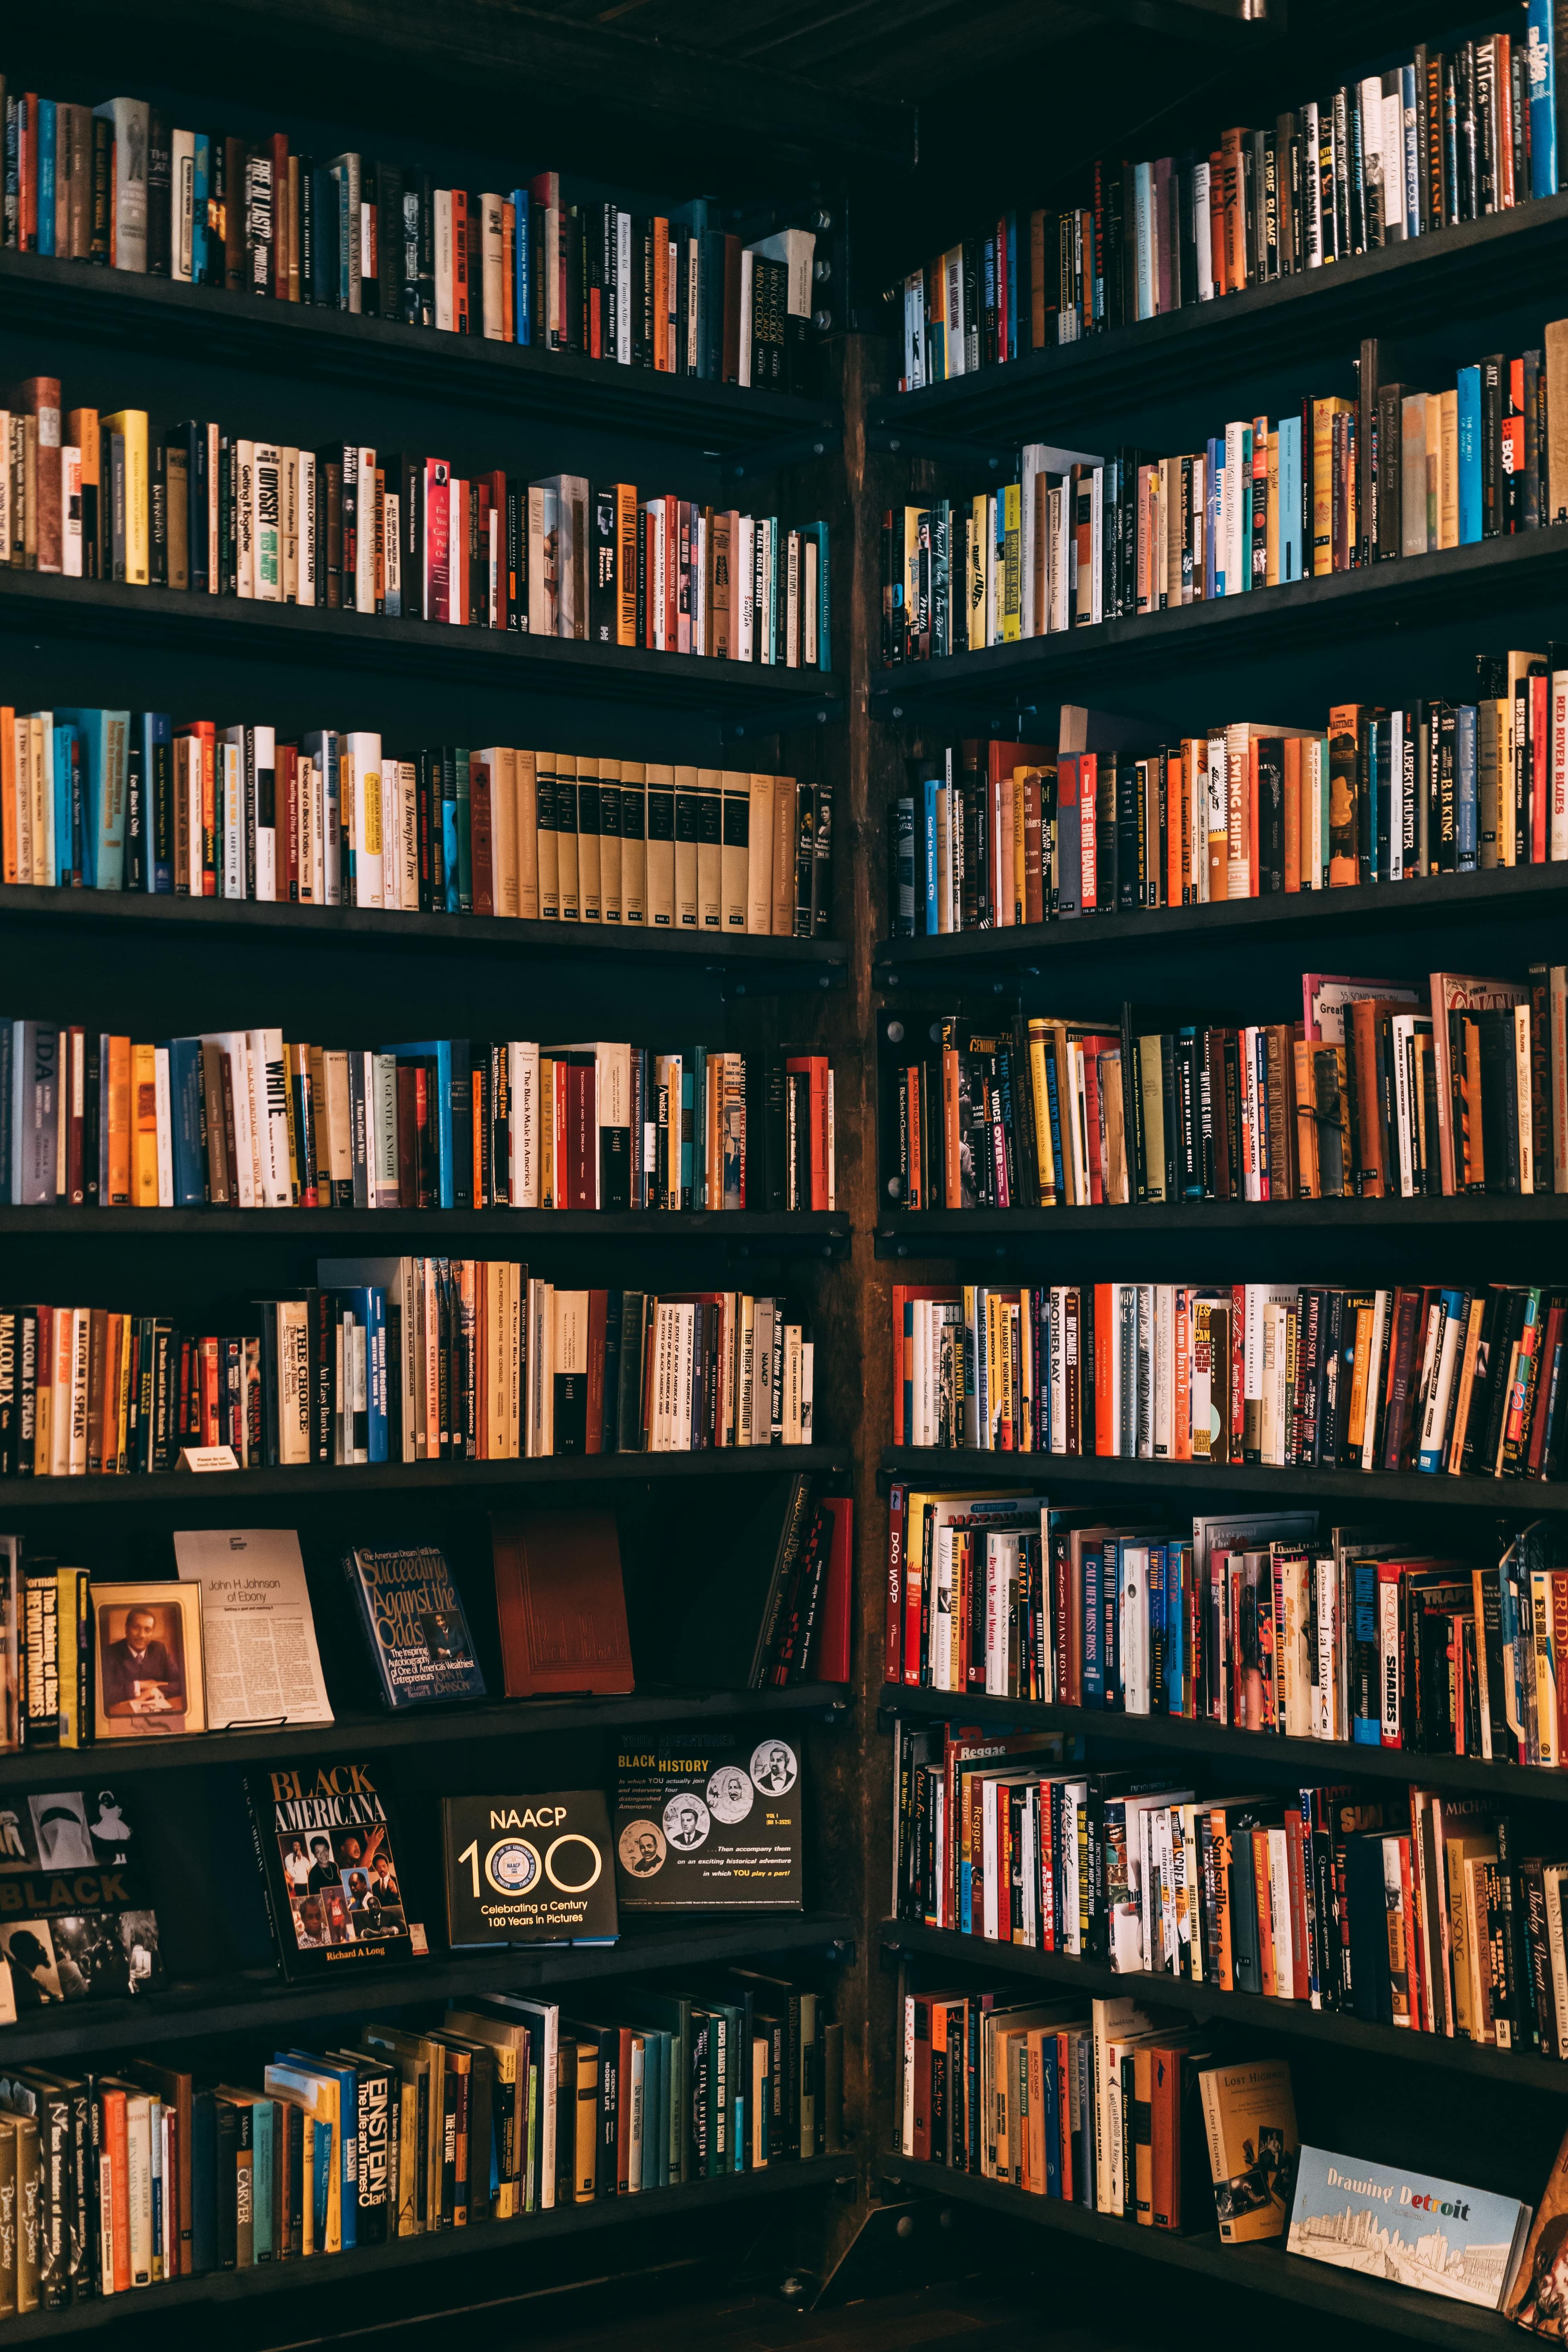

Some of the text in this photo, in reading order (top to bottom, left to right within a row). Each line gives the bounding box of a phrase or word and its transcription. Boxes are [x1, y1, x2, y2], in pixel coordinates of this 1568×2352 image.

[252, 158, 271, 284] FREE AT LAST? POWLEDGE
[241, 465, 250, 500] Getting
[259, 468, 278, 527] ODYSSEY
[243, 510, 251, 552] Together
[308, 511, 314, 522] OF
[308, 526, 314, 539] NO
[972, 545, 984, 610] BIRD LIVES
[1555, 696, 1566, 815] RED RIVER BLUES
[1404, 740, 1414, 849] ALBERTA HUNTER
[129, 818, 138, 837] Only
[405, 789, 415, 880] The Honey-pod Tree
[1082, 795, 1094, 897] THE BIG BANDS
[265, 1060, 287, 1118] WHITE
[1185, 1109, 1191, 1119] OF
[525, 1138, 530, 1147] In
[991, 1089, 1003, 1165] VOICE OVER
[1307, 1296, 1319, 1371] DIVIDED SOUL
[298, 1326, 308, 1434] THE CHOICE:
[742, 1328, 753, 1429] The Black Revolution
[956, 1343, 964, 1401] BELAFONTE
[1052, 1359, 1060, 1383] RAY
[317, 1365, 330, 1442] An Easy Burden
[209, 1579, 280, 1591] John H. Johnson
[359, 1548, 448, 1586] Succeeding
[889, 1532, 900, 1603] DOO WOP
[227, 1592, 266, 1603] of Ebony
[27, 1590, 44, 1718] REVOLUTIONARIES
[44, 1589, 58, 1715] The Making of Black
[376, 1612, 424, 1649] Odds
[388, 1656, 430, 1668] Autobiography
[392, 1674, 434, 1685] Entrepreneurs
[1319, 1626, 1330, 1691] La Toya
[1387, 1655, 1396, 1722] SHADES
[268, 1764, 377, 1802] BLACK
[619, 1755, 708, 1772] BLACK HISTORY
[275, 1794, 388, 1832] AMERICANA
[490, 1807, 567, 1829] NAACP
[972, 1806, 982, 1852] Reggae
[0, 1874, 131, 1911] BLACK
[458, 1834, 601, 1897] 100
[481, 1903, 537, 1914] Celebrating
[550, 1901, 588, 1911] Century
[488, 1917, 506, 1927] 100
[508, 1916, 533, 1926] Years
[547, 1913, 583, 1923] Pictures
[1451, 1892, 1464, 1962] TIV SONG
[327, 1950, 356, 1961] Richard
[366, 1947, 385, 1956] Long
[1528, 1883, 1546, 1993] Shirley Verrett
[359, 2083, 370, 2192] The Life and Times
[369, 2078, 388, 2192] EINSTEIN
[1212, 2134, 1221, 2177] HIGHWAY
[238, 2168, 249, 2225] CARVER
[1327, 2168, 1470, 2221] Drawing Detroit
